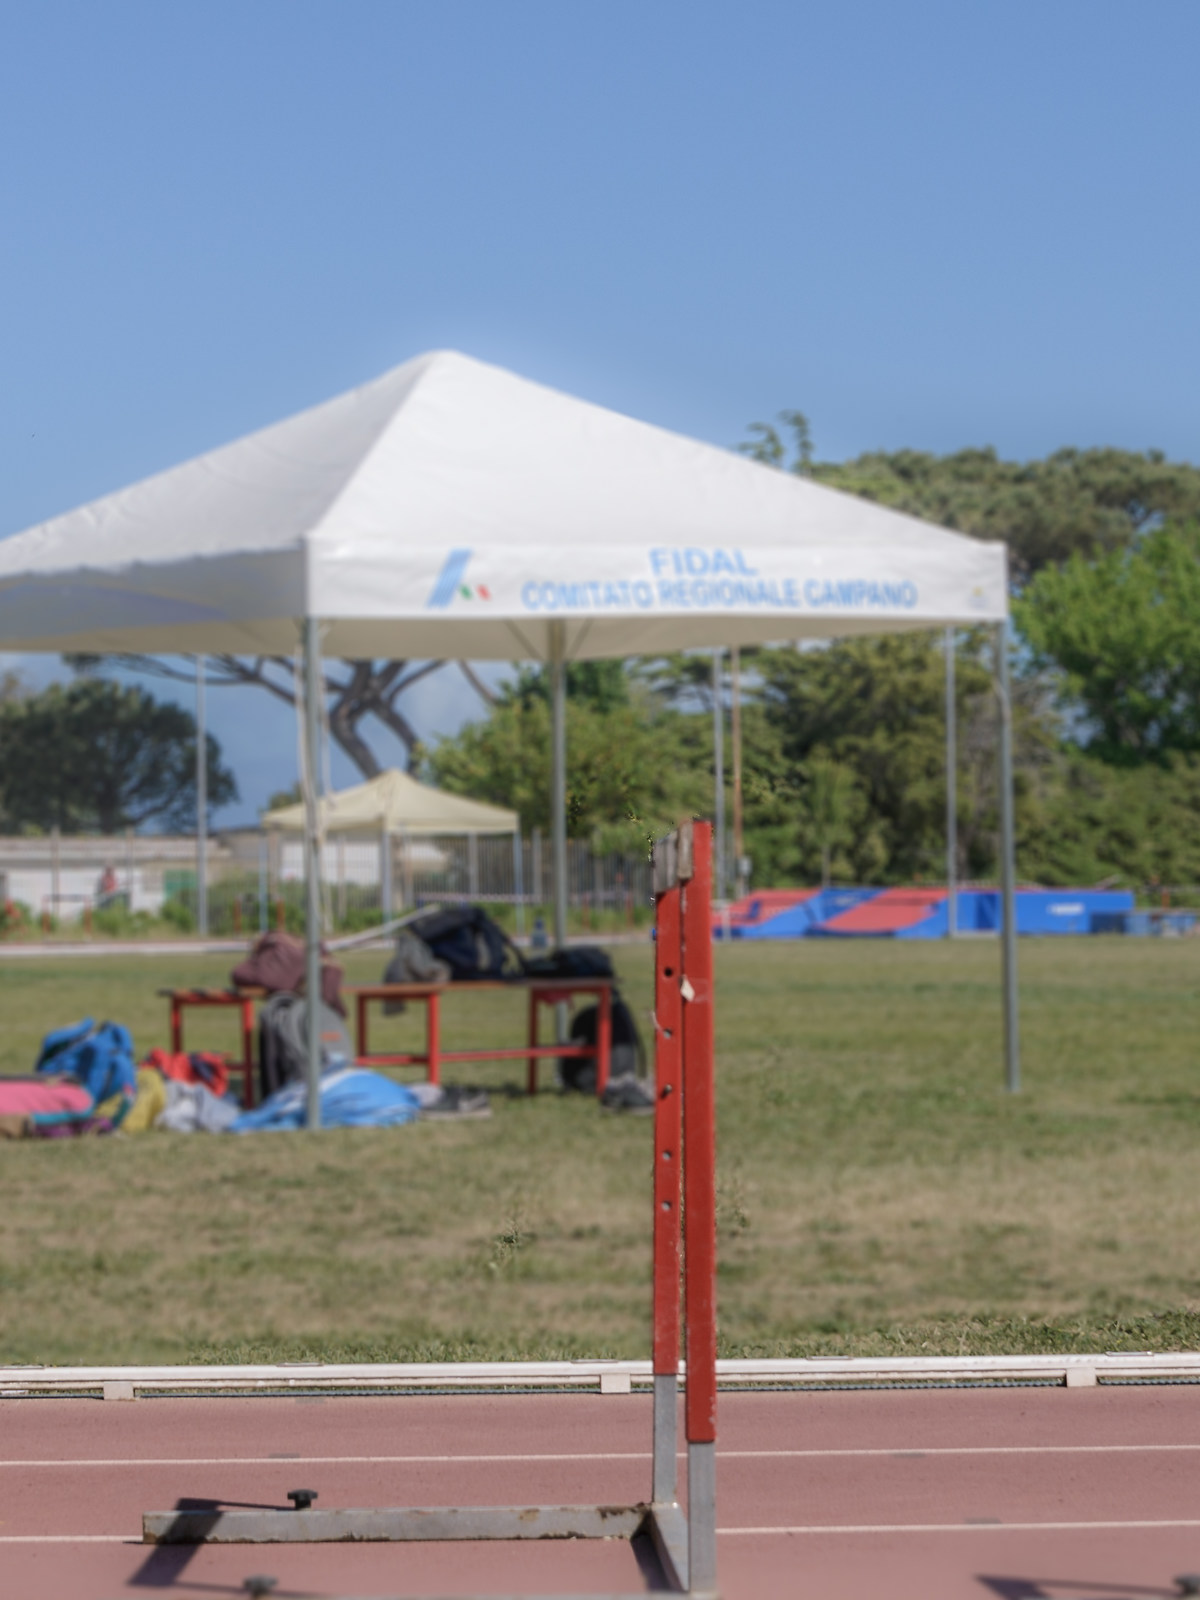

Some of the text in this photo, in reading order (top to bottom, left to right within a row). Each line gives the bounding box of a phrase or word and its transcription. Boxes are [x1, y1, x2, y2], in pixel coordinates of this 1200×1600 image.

[648, 547, 757, 576] FIDAL
[520, 579, 918, 610] COMITATO REGIONALE CAMPANO
